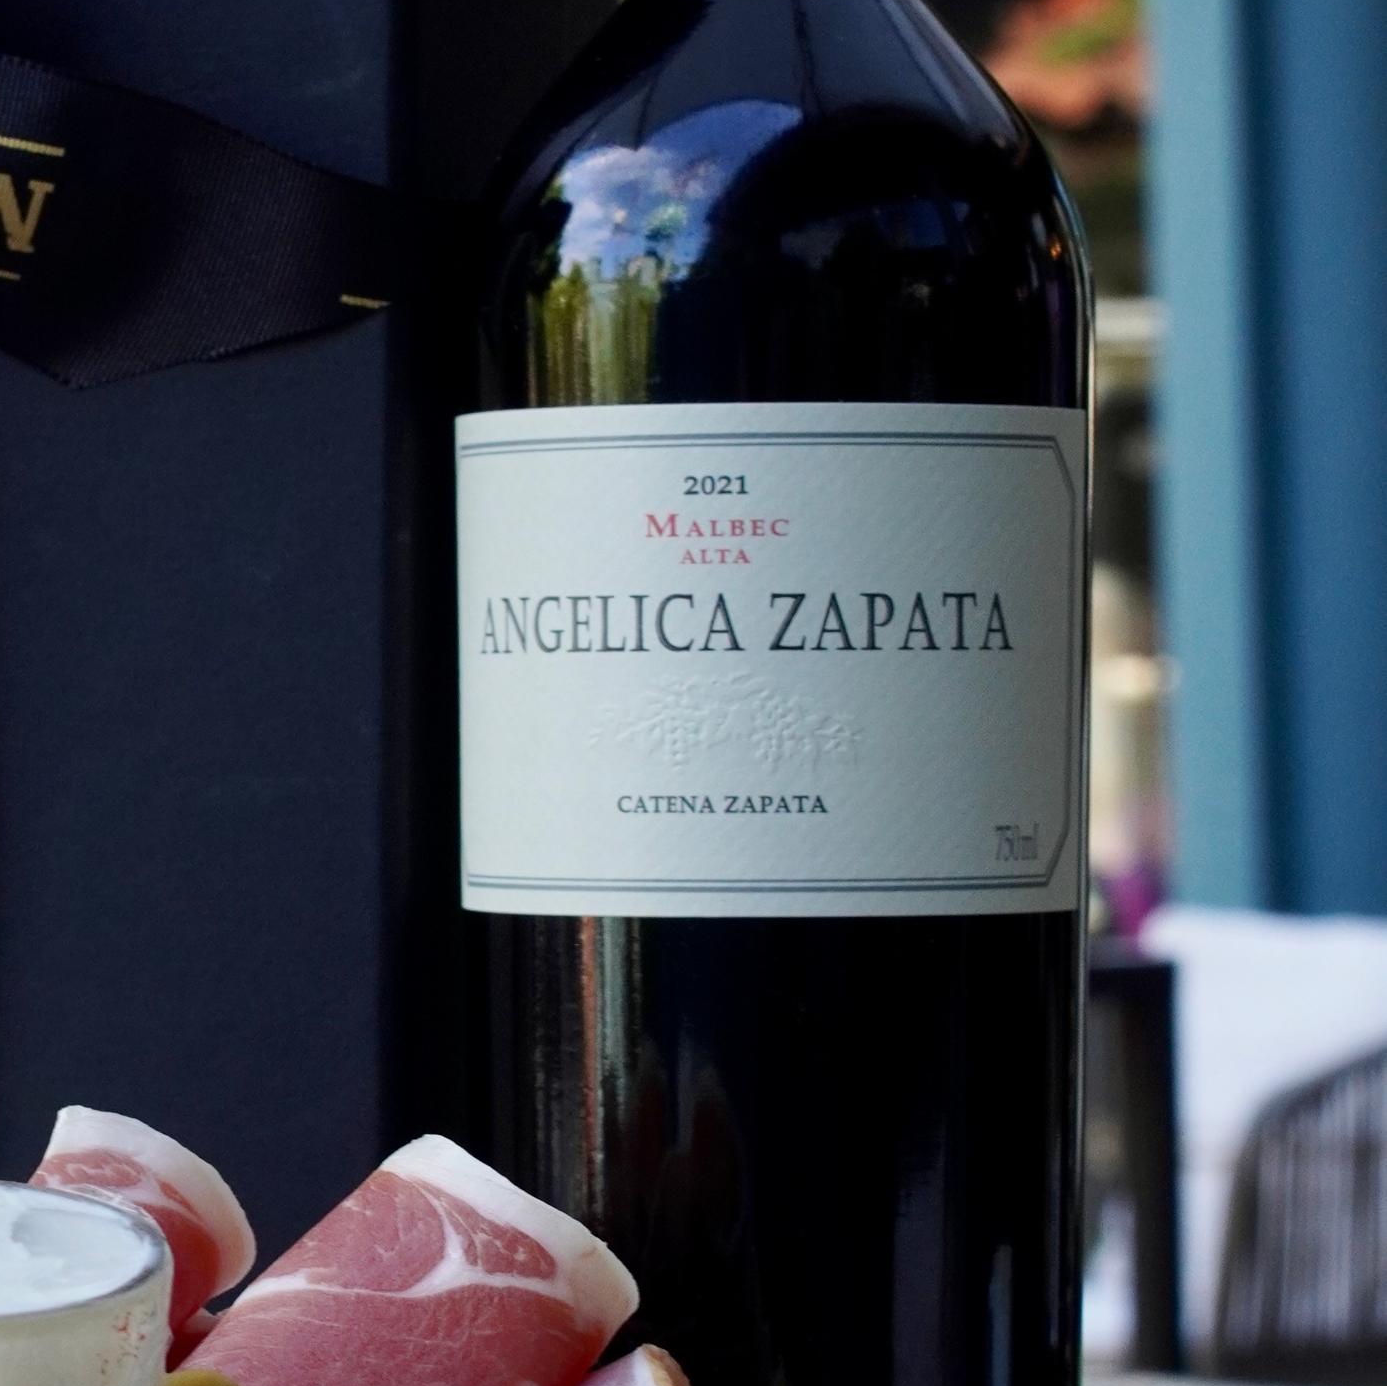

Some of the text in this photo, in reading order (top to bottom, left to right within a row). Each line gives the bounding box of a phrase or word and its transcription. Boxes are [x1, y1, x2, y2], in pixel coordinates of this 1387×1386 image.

[683, 475, 750, 496] 2021
[645, 513, 790, 539] MALBEC
[679, 547, 752, 565] ALTA
[480, 592, 1015, 655] ANGELICA ZAPATA
[617, 795, 828, 814] CATENA ZAPATA
